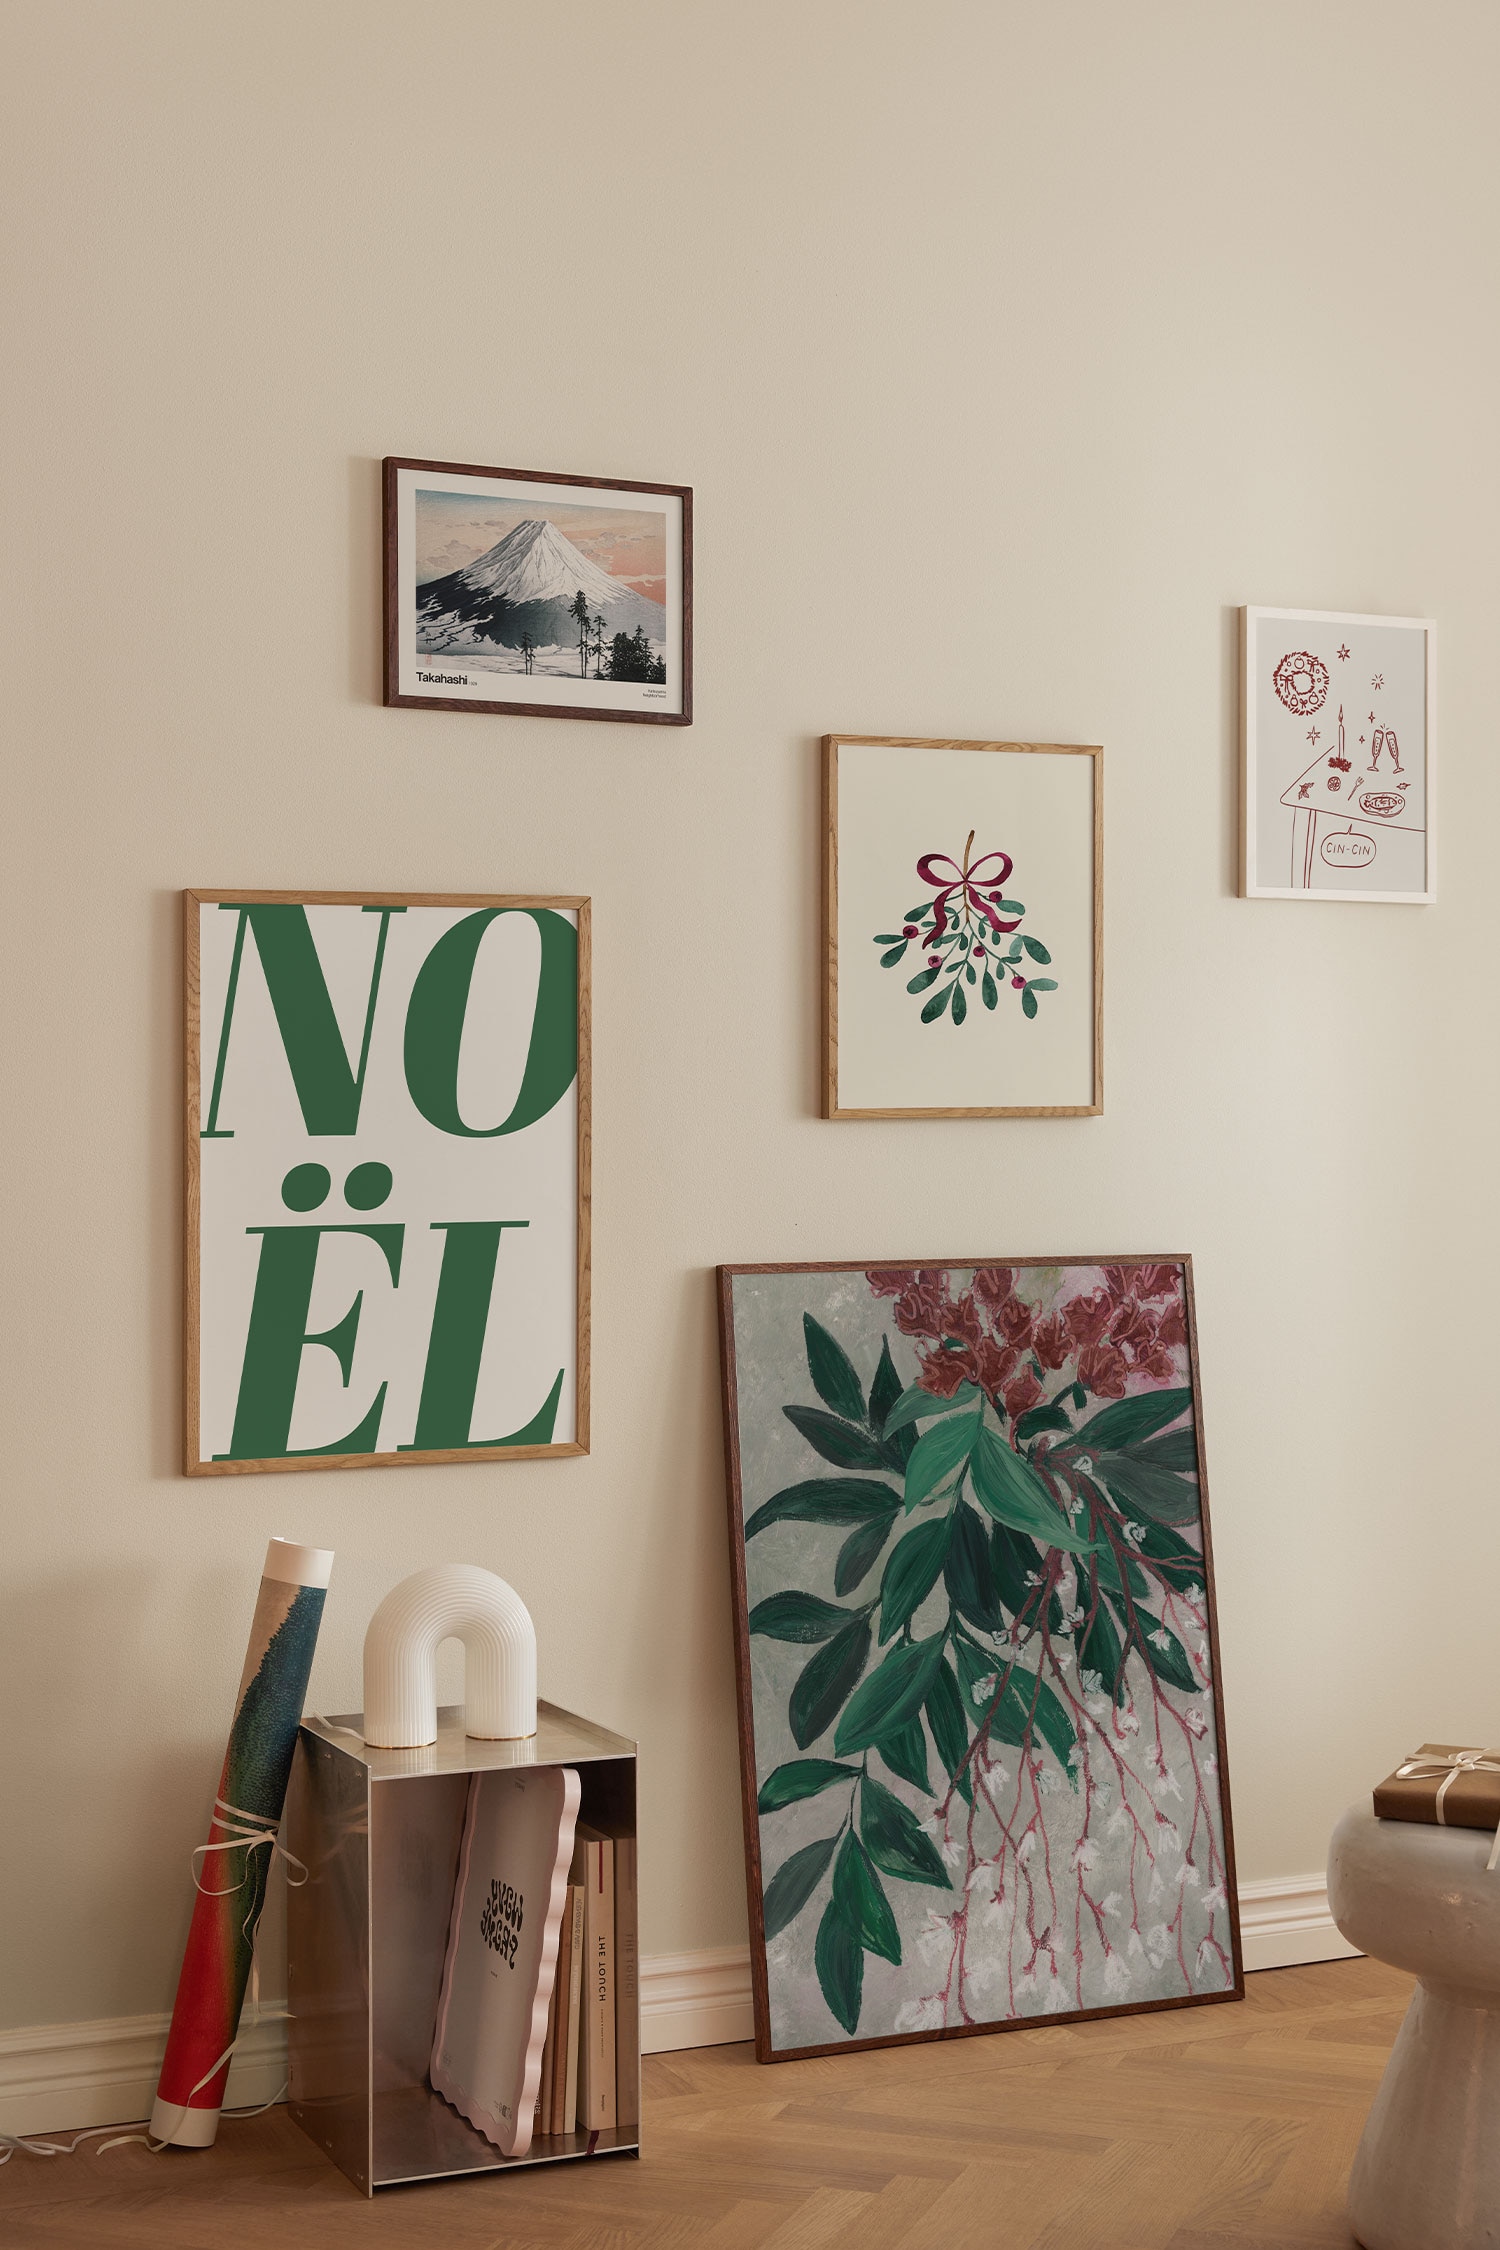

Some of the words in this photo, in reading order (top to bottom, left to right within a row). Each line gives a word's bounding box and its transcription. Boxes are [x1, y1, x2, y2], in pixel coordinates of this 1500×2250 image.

[416, 671, 468, 685] Takahashi
[1326, 842, 1371, 855] CIN-CIN
[200, 903, 577, 1138] NO
[212, 1161, 566, 1462] ËL
